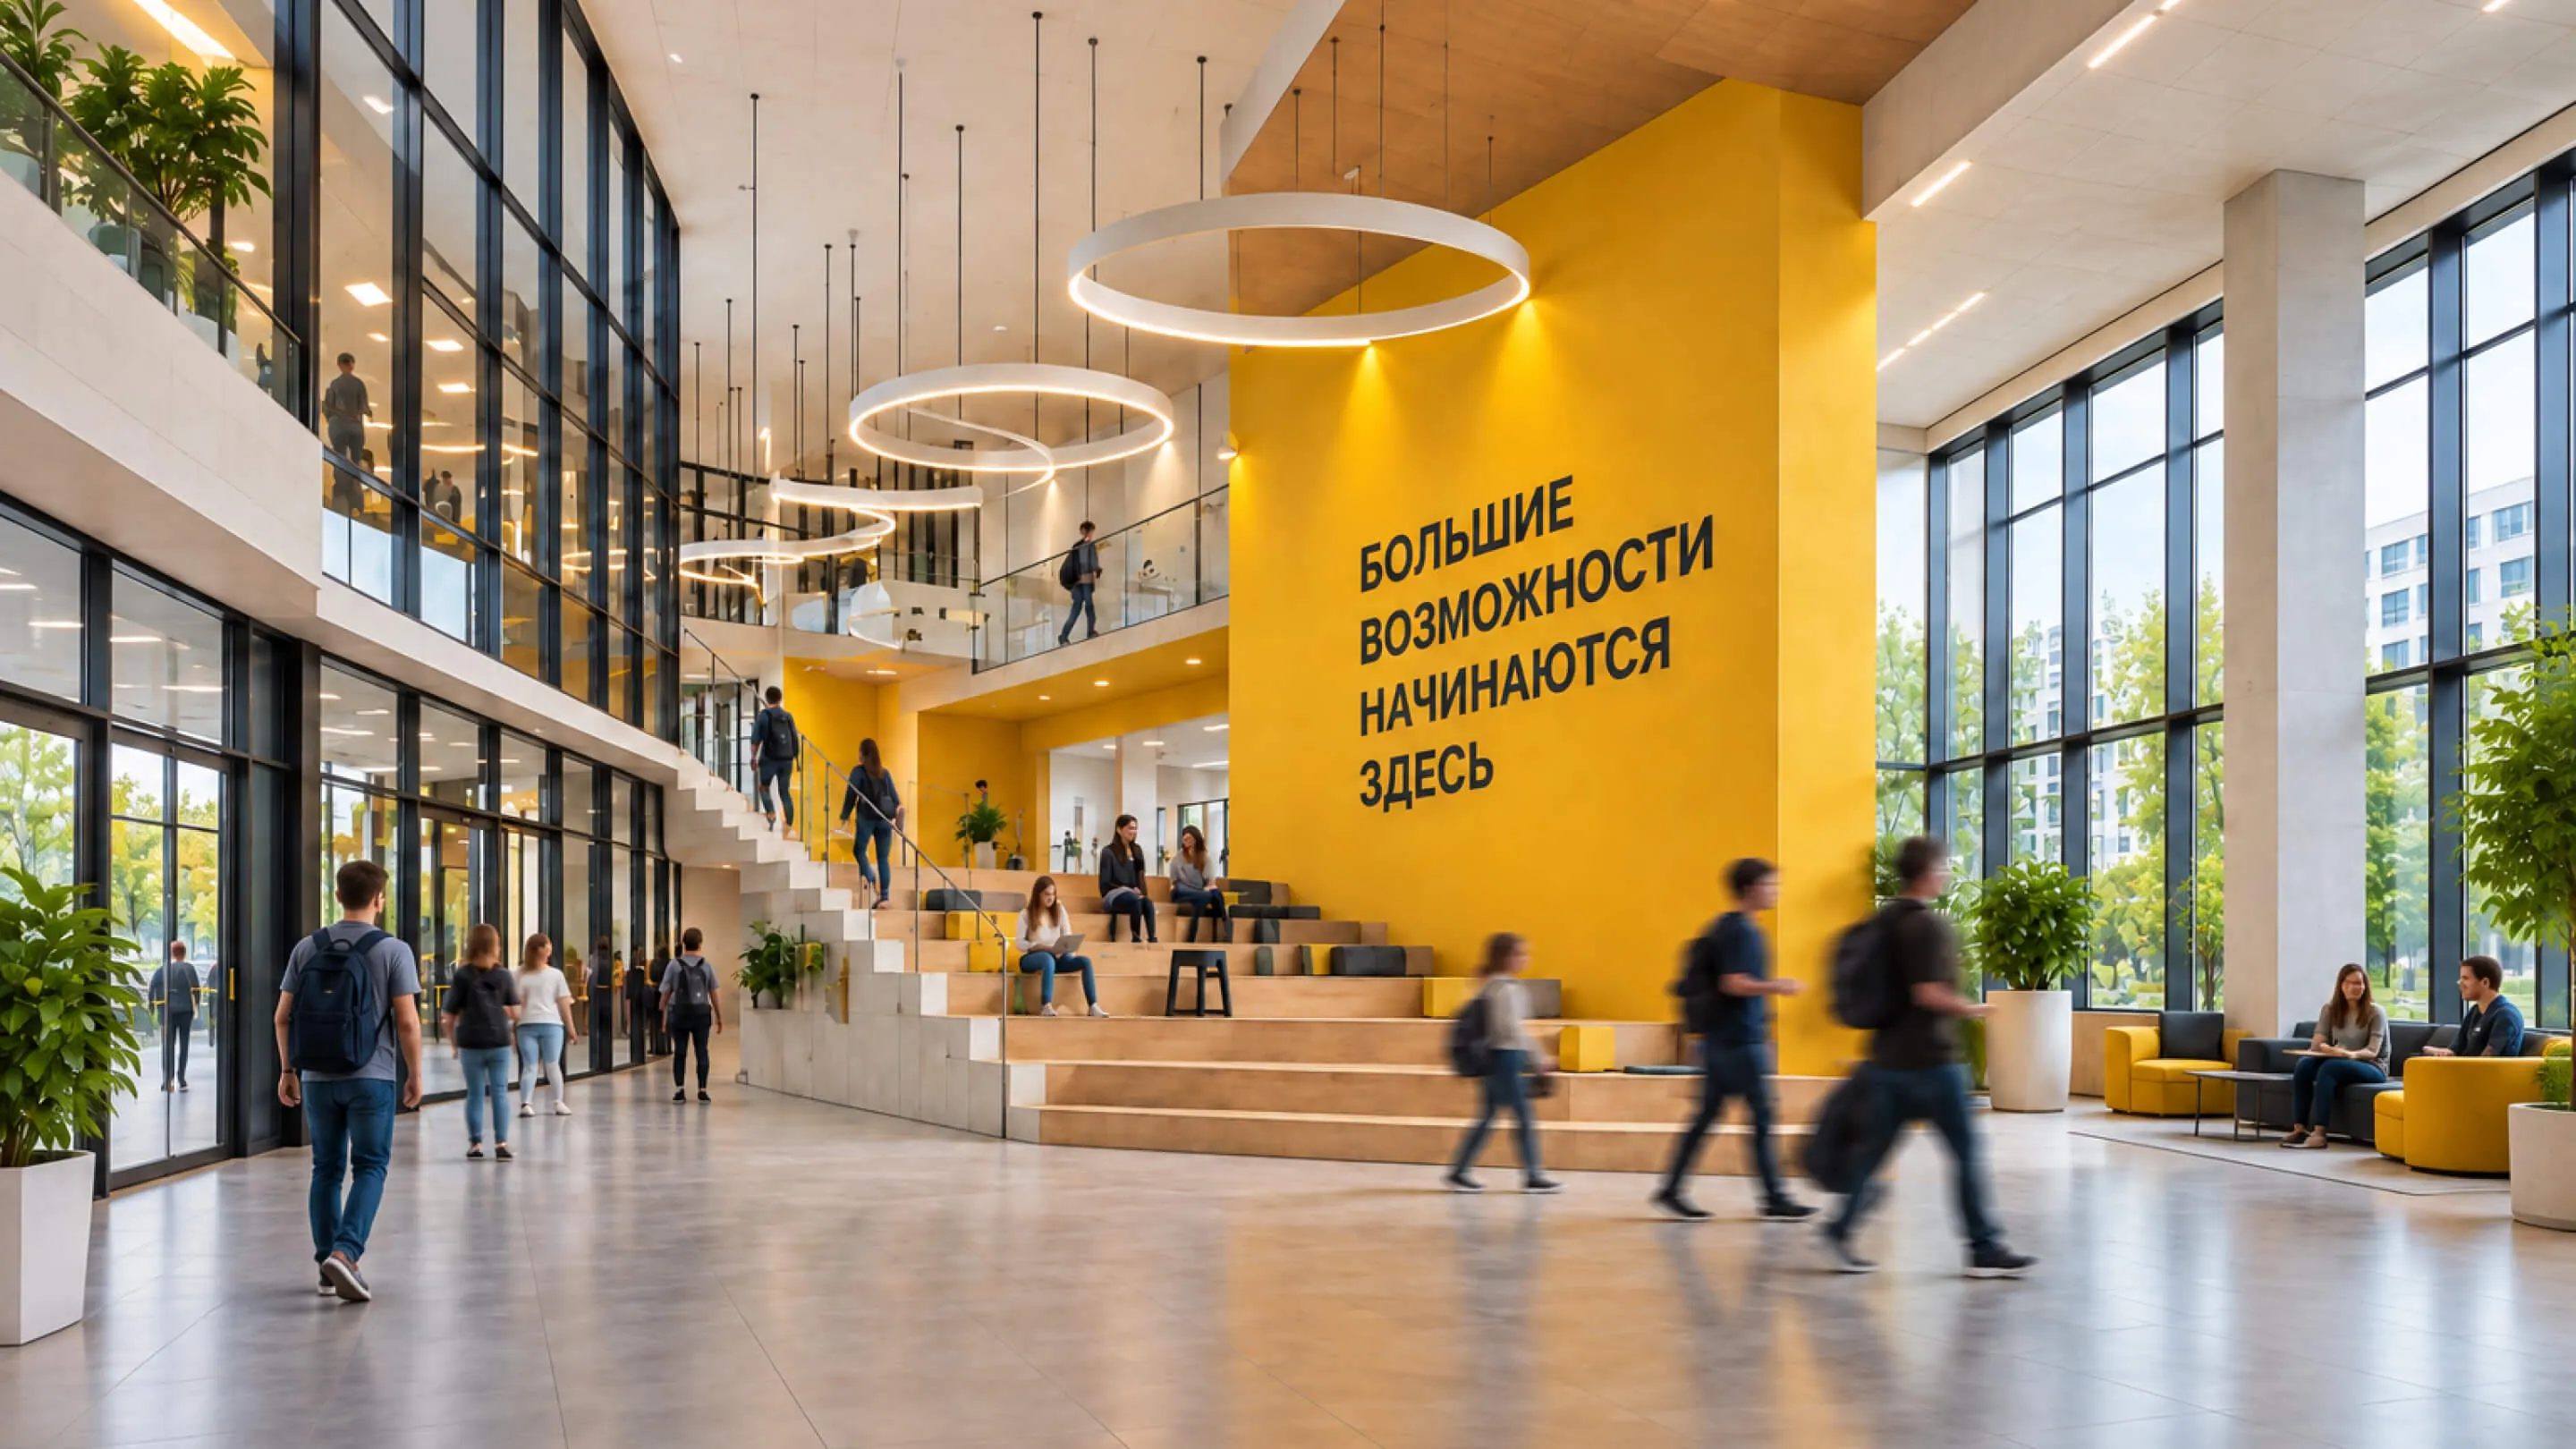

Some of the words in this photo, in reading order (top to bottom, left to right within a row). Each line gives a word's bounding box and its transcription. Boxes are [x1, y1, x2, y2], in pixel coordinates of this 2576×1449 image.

[1360, 474, 1574, 593] БОЛЬШИЕ
[1360, 514, 1714, 666] ВОЗМОЖНОСТИ
[1360, 614, 1671, 737] НАЧИНАЮТСЯ
[1360, 741, 1494, 813] ЗДЕСЬ
